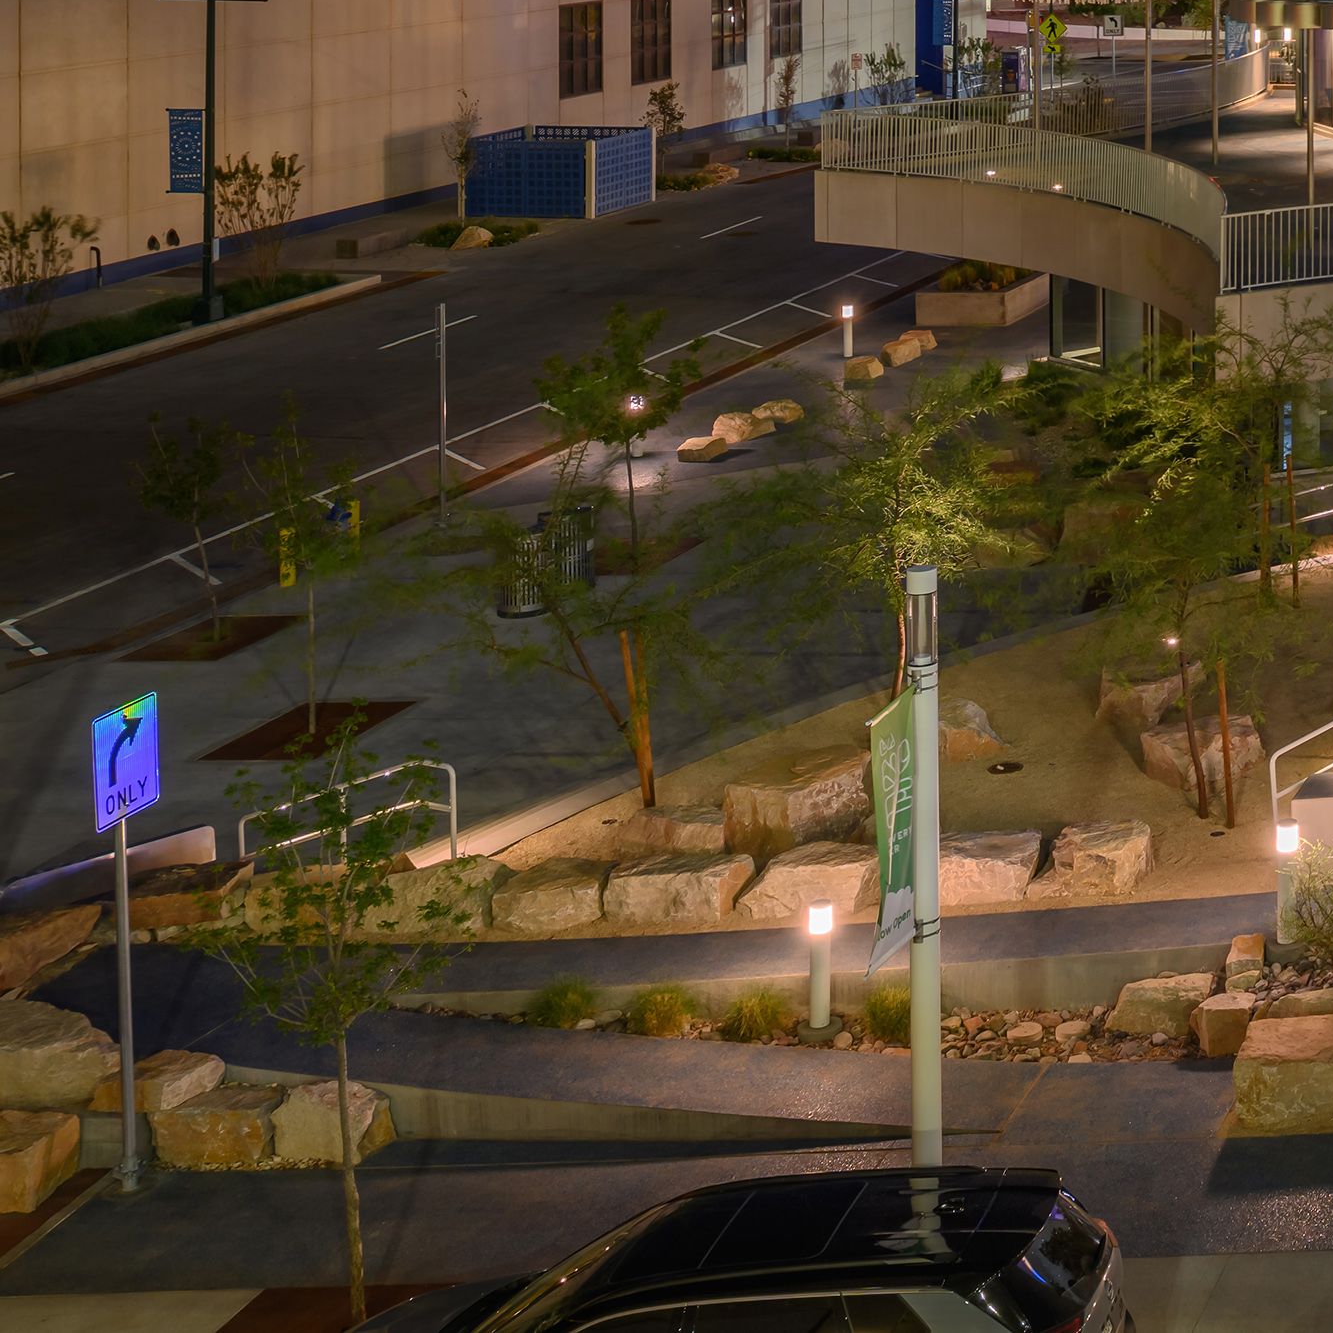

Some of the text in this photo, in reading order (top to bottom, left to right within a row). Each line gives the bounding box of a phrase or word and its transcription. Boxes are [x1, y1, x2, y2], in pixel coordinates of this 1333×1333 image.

[105, 776, 149, 816] ONLY
[877, 909, 912, 941] ow Open
